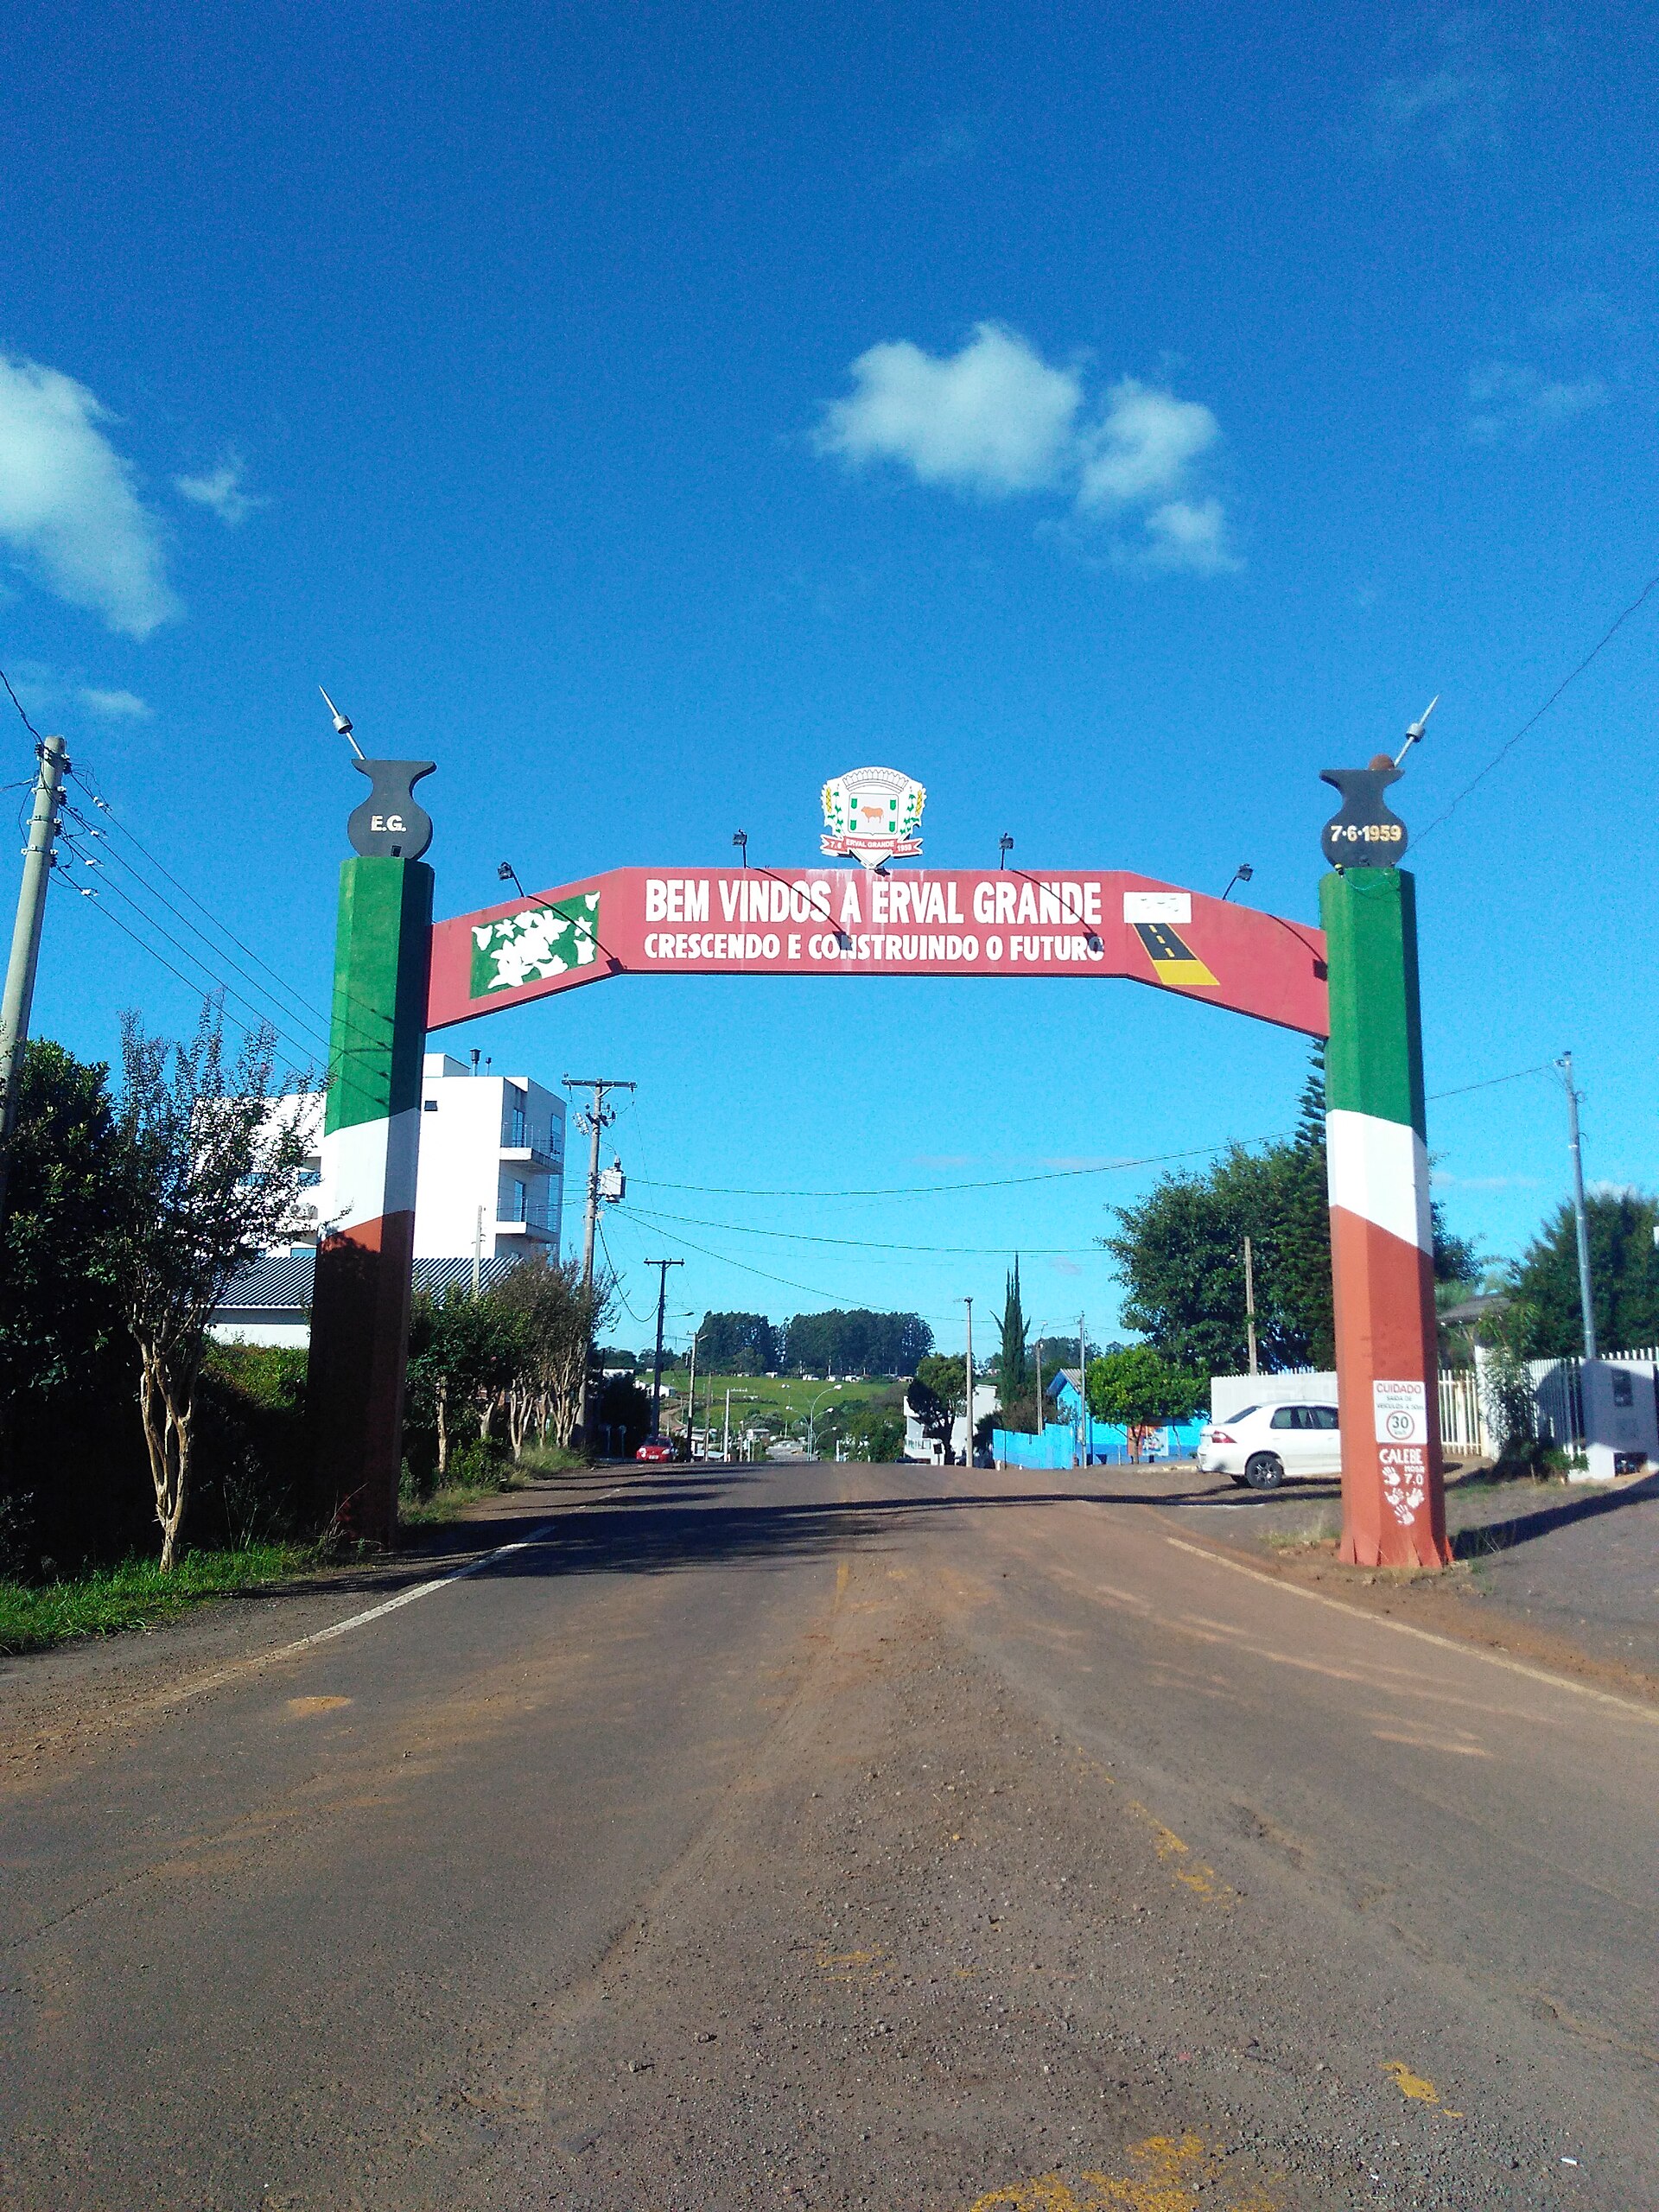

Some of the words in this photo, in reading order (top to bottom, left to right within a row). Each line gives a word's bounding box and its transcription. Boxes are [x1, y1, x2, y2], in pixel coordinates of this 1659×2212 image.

[371, 815, 407, 831] E.G.
[846, 839, 867, 848] ERVAL
[645, 879, 710, 923] BEM
[718, 880, 833, 924] VINDOS
[840, 880, 862, 924] A
[872, 881, 964, 925] ERVAL
[974, 881, 1103, 925] GRANDE
[645, 933, 781, 960] CRESCENDO
[787, 934, 802, 960] E
[986, 935, 1003, 962] O
[1376, 1383, 1421, 1394] CUIDADO
[1392, 1415, 1409, 1428] 30
[1379, 1448, 1423, 1465] CALEBE
